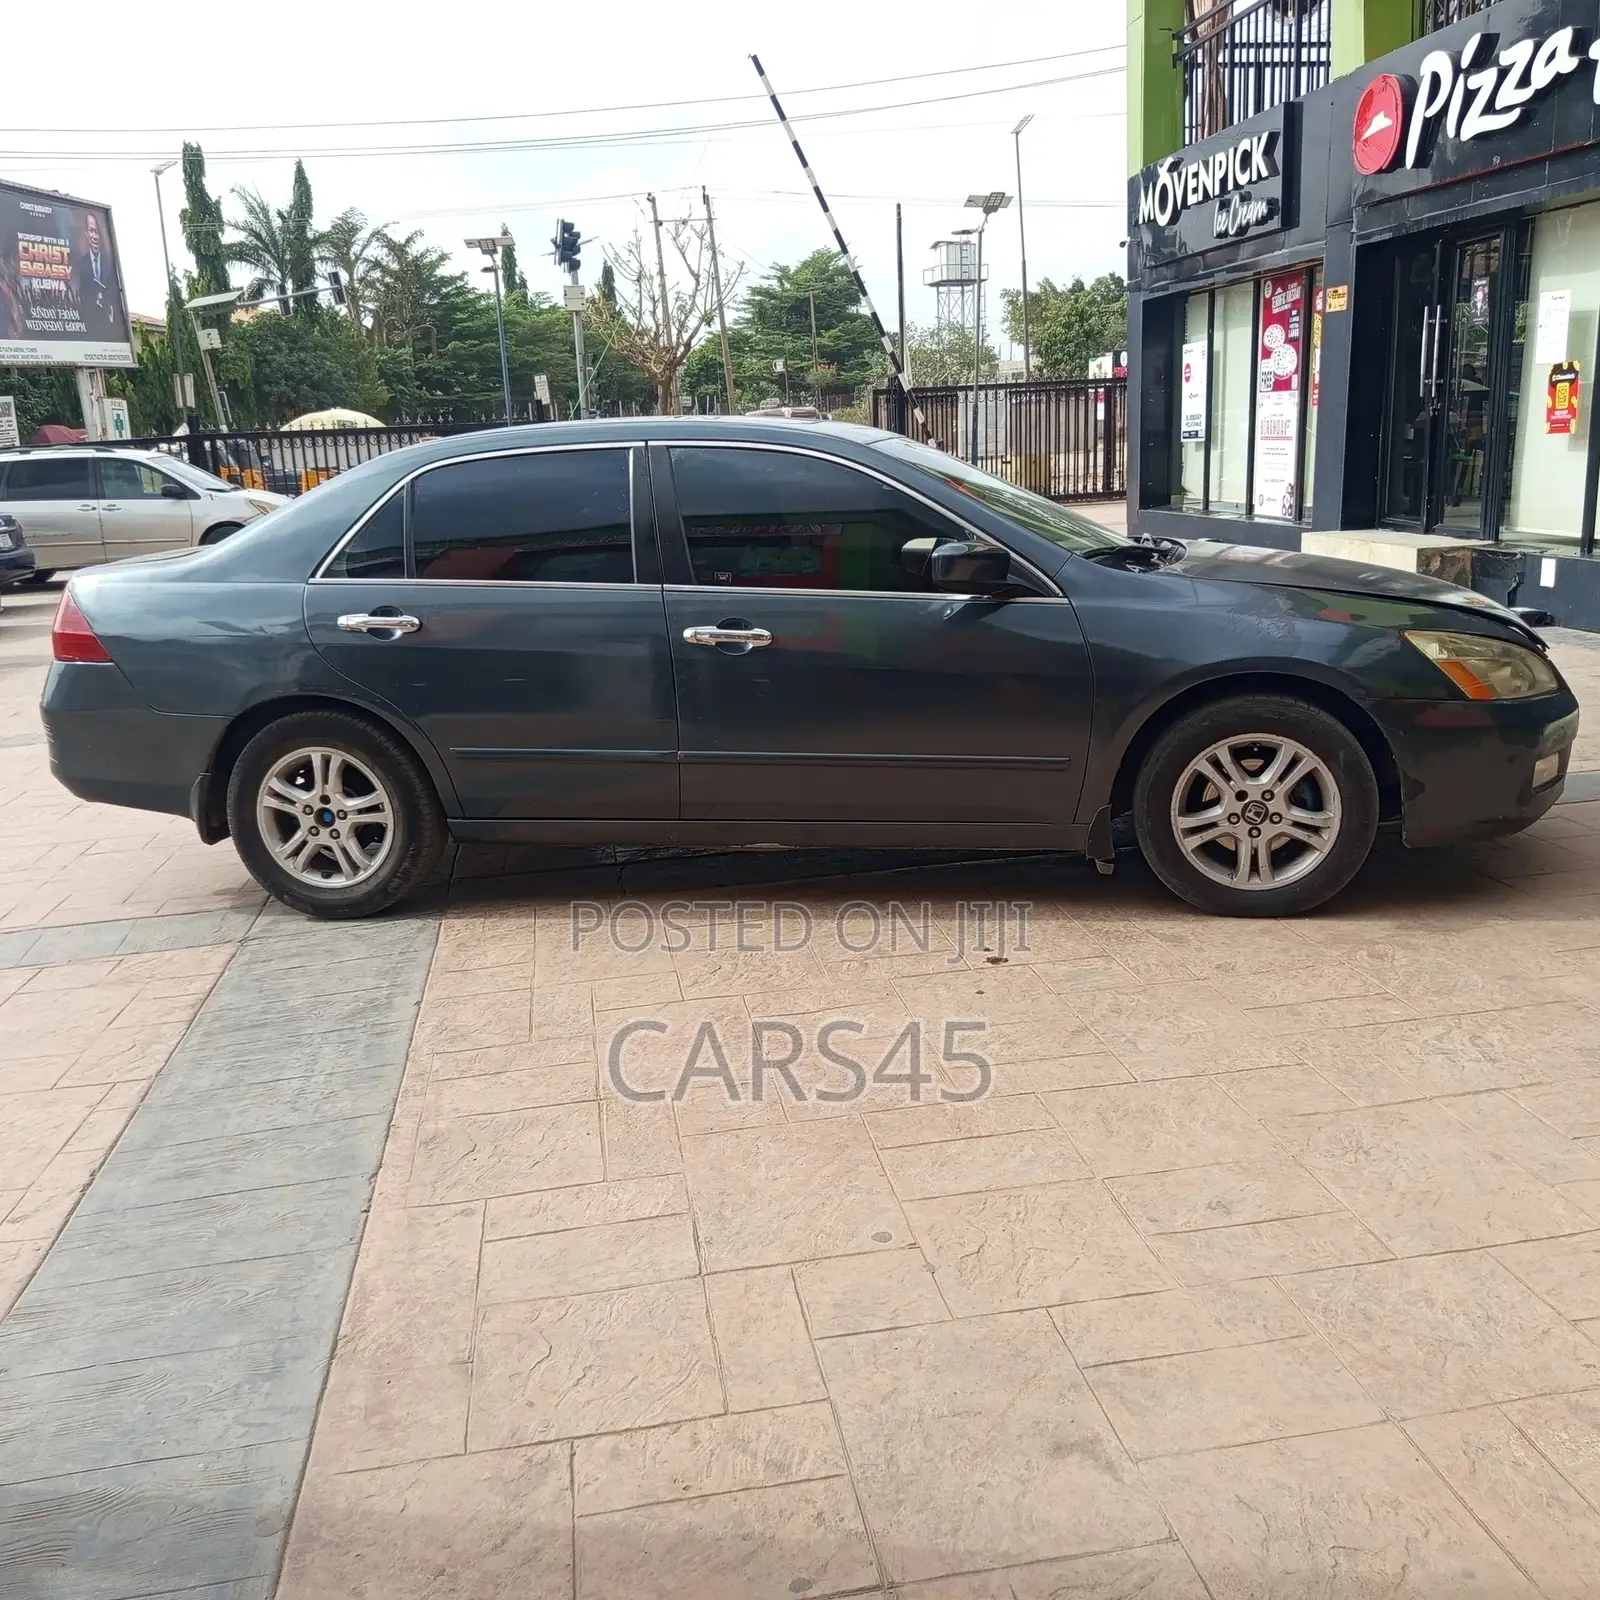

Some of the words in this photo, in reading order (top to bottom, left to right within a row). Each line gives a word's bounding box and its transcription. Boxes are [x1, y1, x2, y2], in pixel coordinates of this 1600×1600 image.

[1405, 26, 1579, 170] Pizza
[1213, 200, 1228, 237] Ice
[1228, 194, 1268, 235] Cream
[17, 232, 42, 242] WORSHIP
[43, 236, 58, 245] WITH
[18, 241, 70, 264] CHRIST
[19, 261, 72, 280] EMBASSY
[32, 278, 67, 291] KUBWA
[30, 306, 57, 320] SUNDAY
[25, 319, 64, 331] WEDNESDAY
